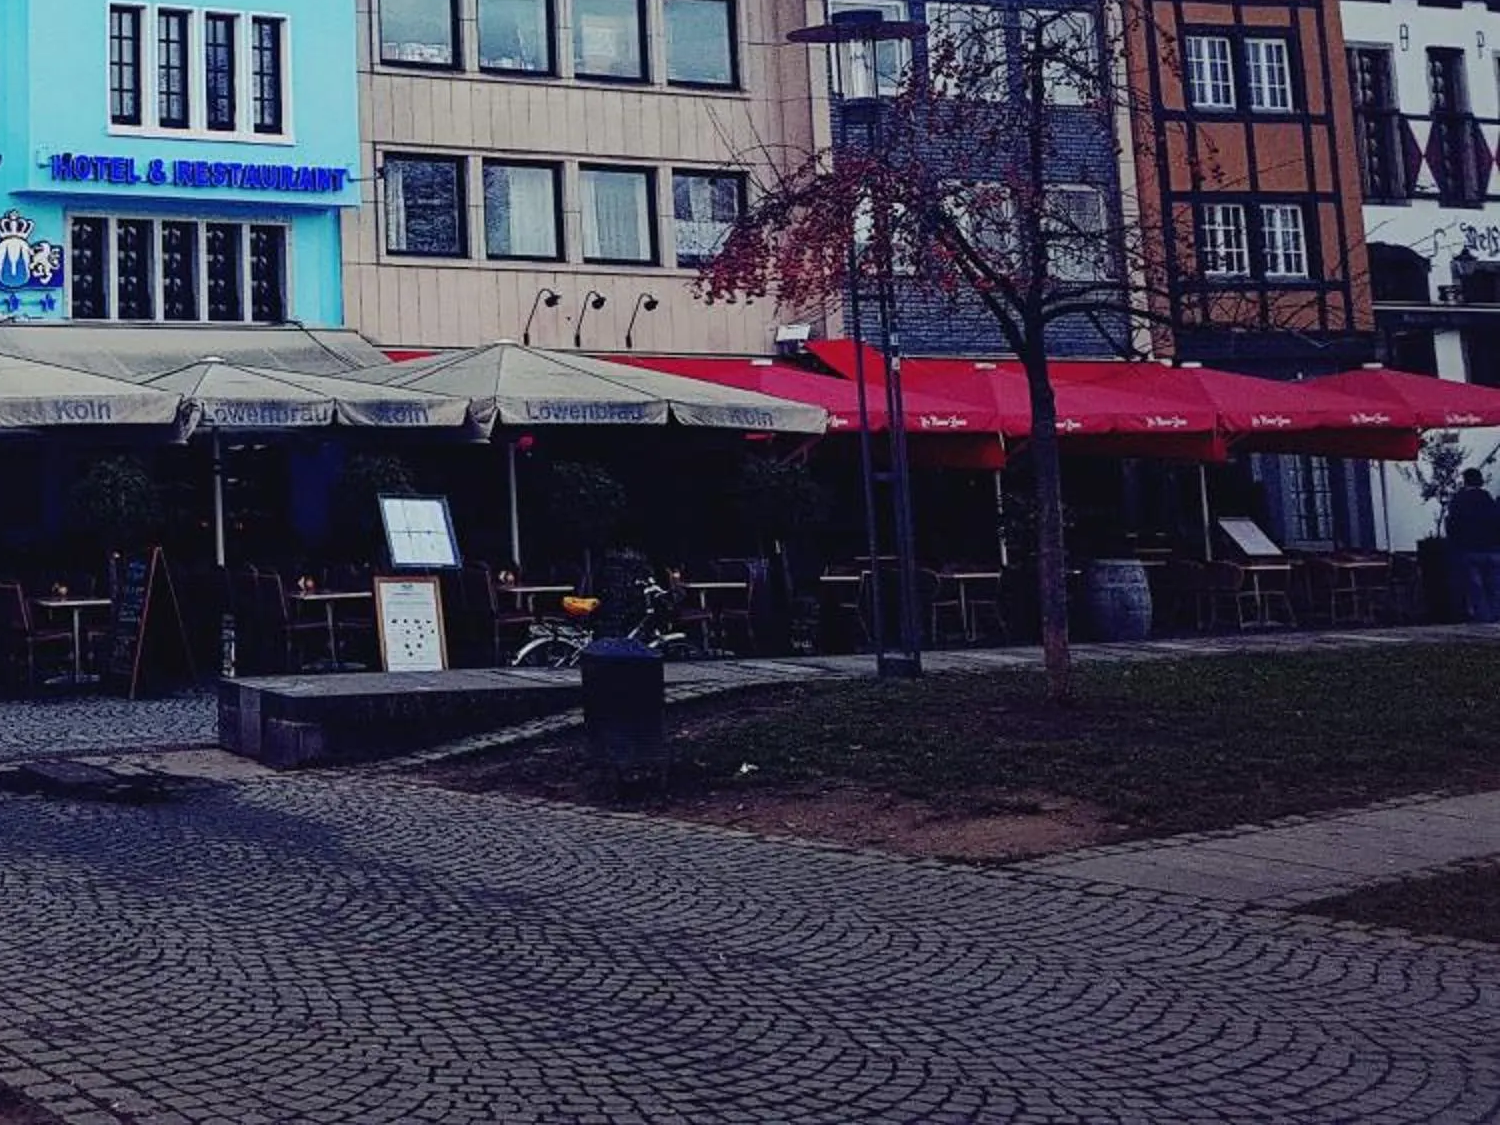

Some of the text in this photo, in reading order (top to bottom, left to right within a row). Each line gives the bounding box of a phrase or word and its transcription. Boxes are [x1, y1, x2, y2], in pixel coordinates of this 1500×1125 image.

[51, 153, 347, 192] HOTEL & RESTAURANT
